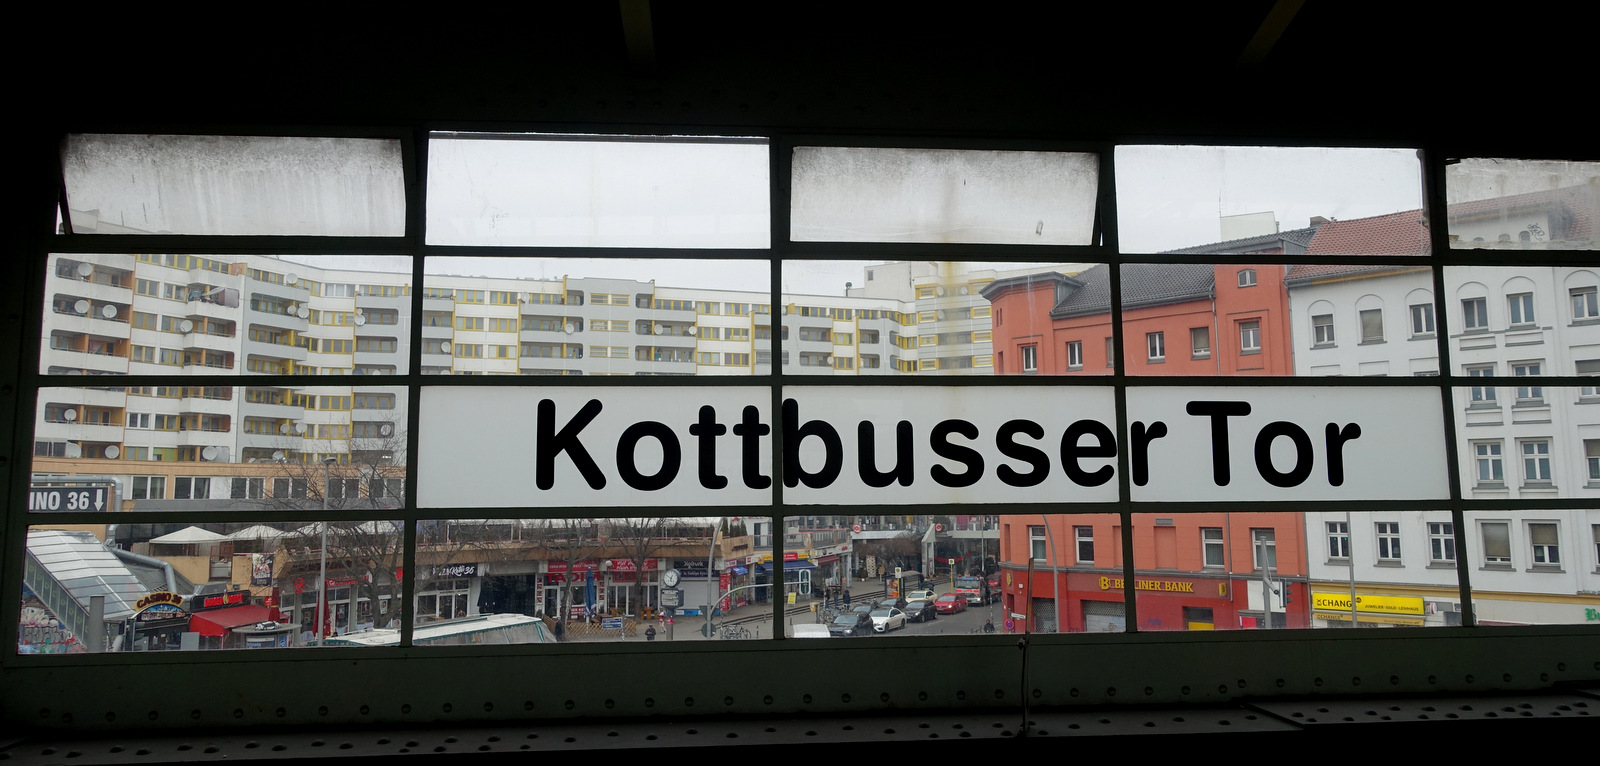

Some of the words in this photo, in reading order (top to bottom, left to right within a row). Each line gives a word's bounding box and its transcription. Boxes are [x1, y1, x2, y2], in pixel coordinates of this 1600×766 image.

[534, 397, 1167, 491] Kottbusser
[1186, 400, 1362, 488] Tor
[67, 491, 89, 510] 36
[1164, 582, 1194, 592] BANK
[137, 593, 171, 609] CASINO
[171, 594, 182, 605] 36
